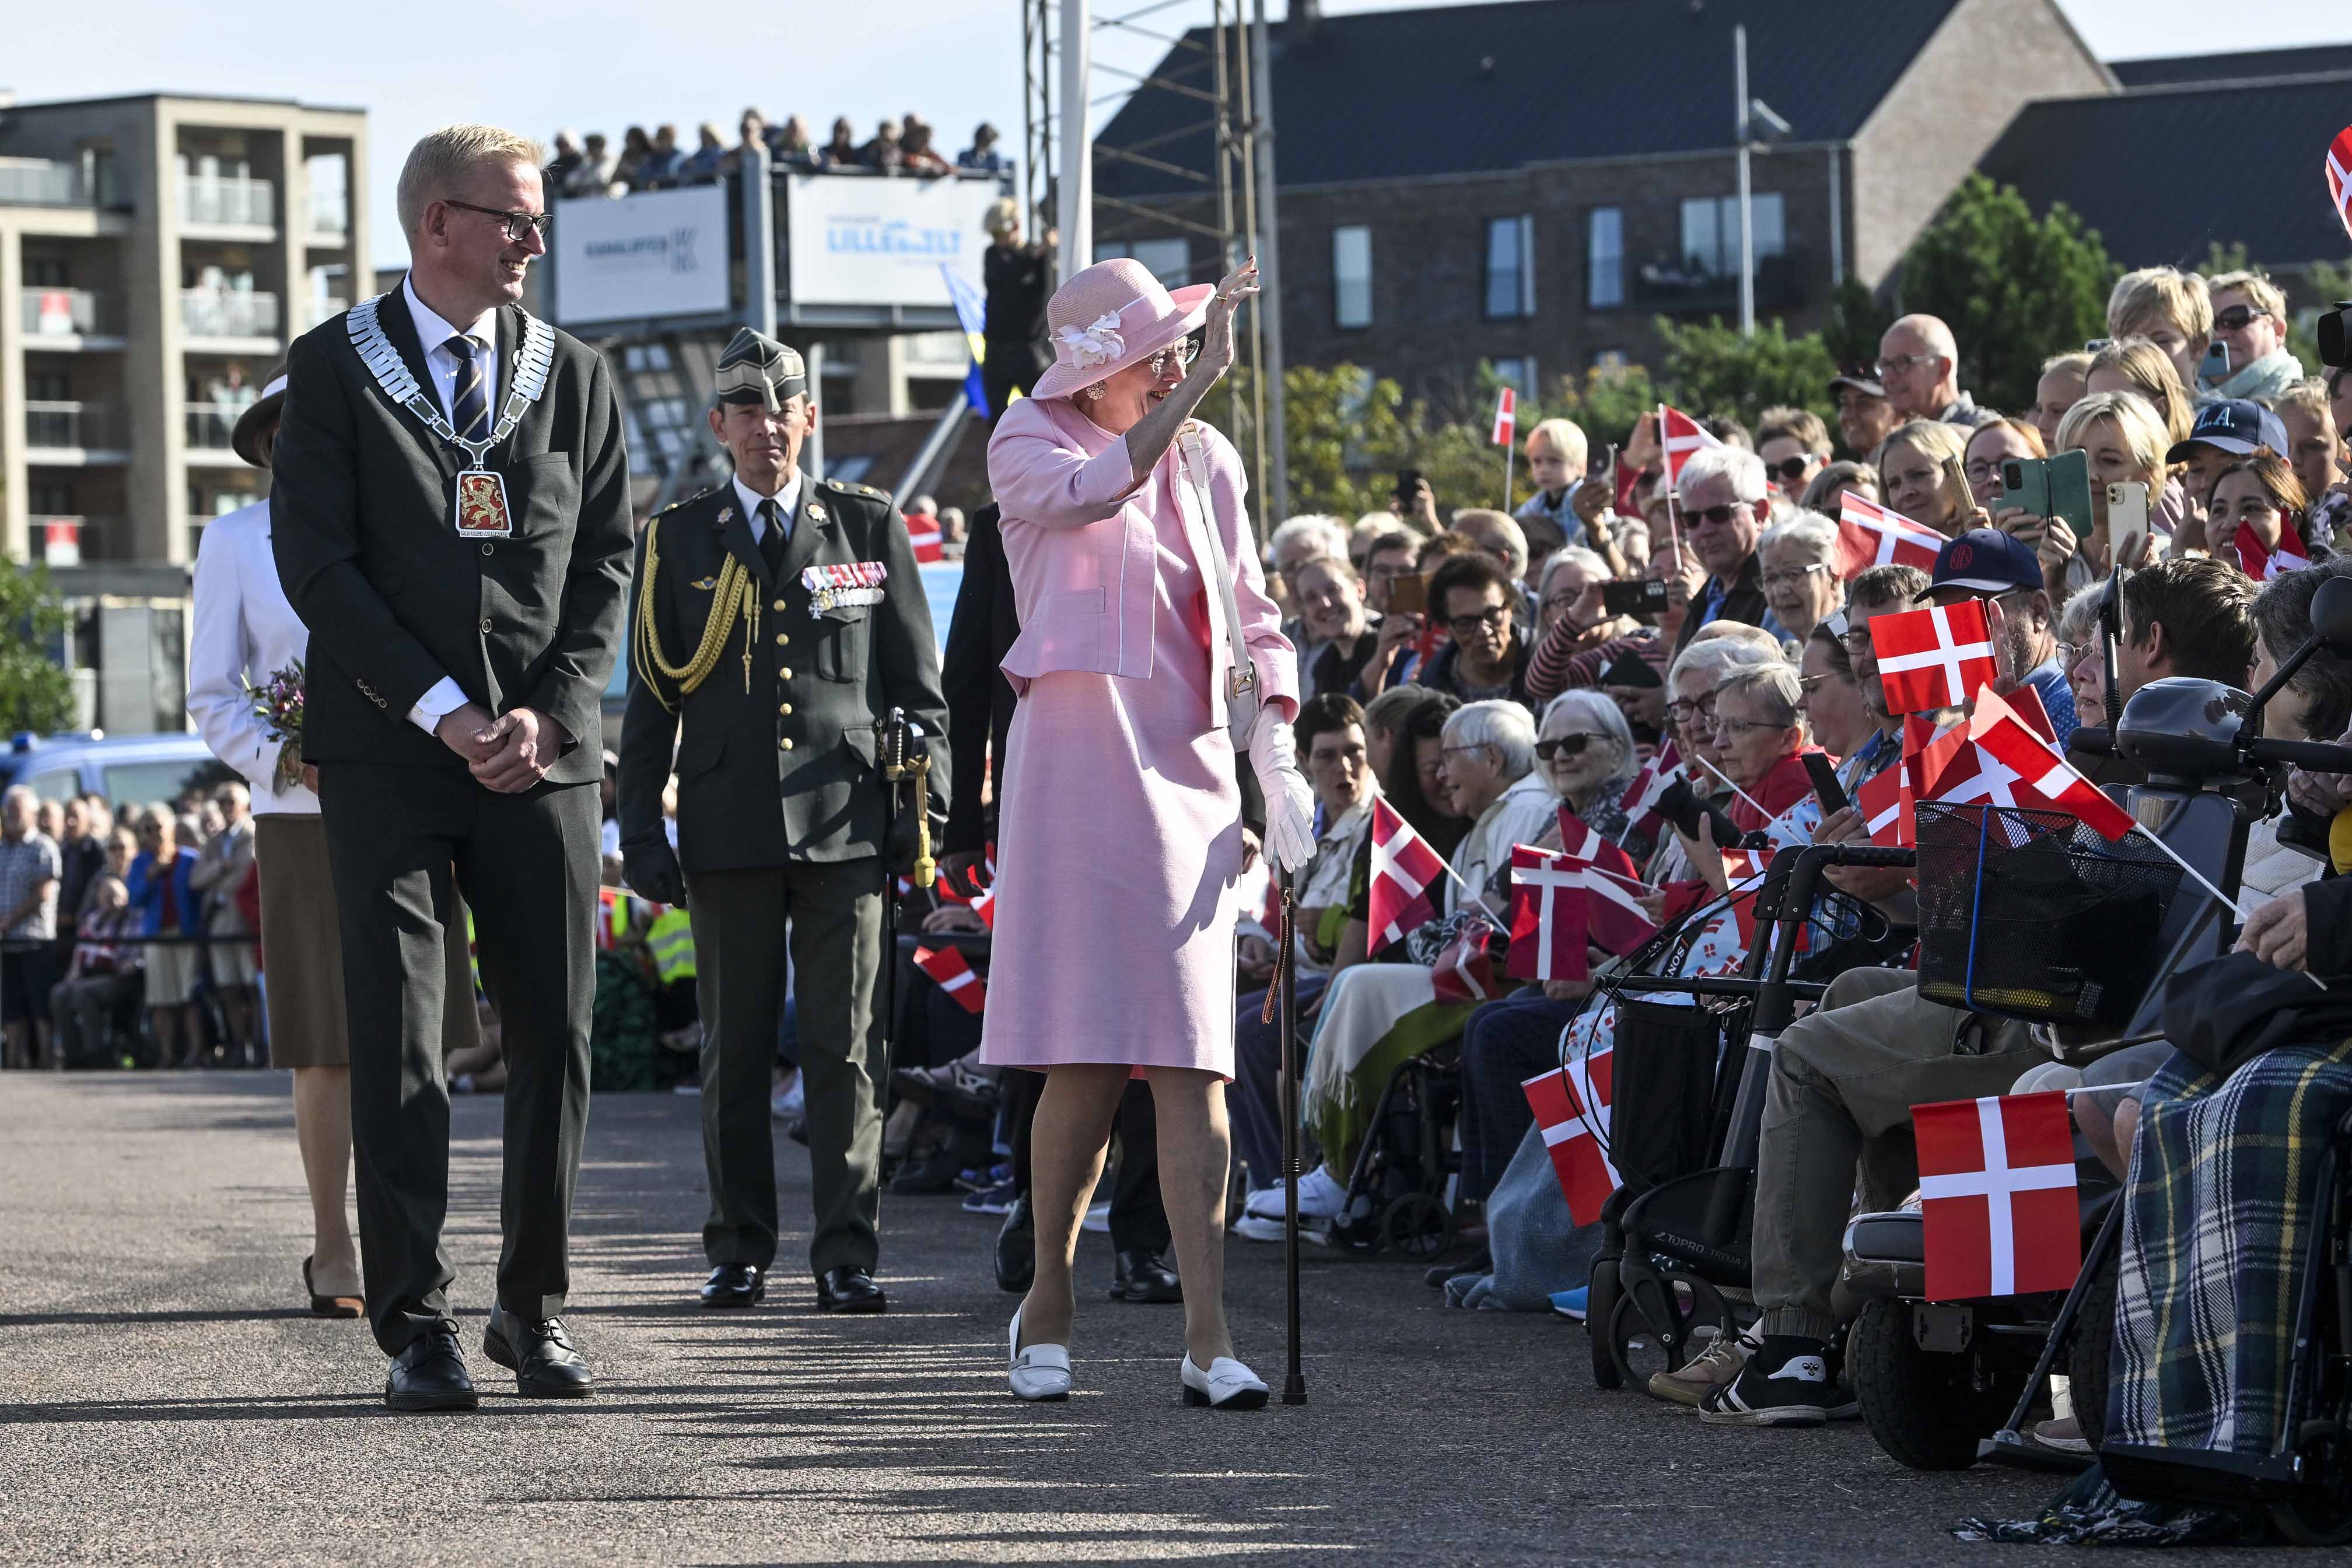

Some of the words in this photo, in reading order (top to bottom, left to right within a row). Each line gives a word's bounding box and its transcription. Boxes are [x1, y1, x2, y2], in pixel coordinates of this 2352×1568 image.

[2196, 407, 2235, 429] L.A.
[1667, 1233, 1705, 1254] TOPRO
[1710, 1248, 1741, 1265] TROJA
